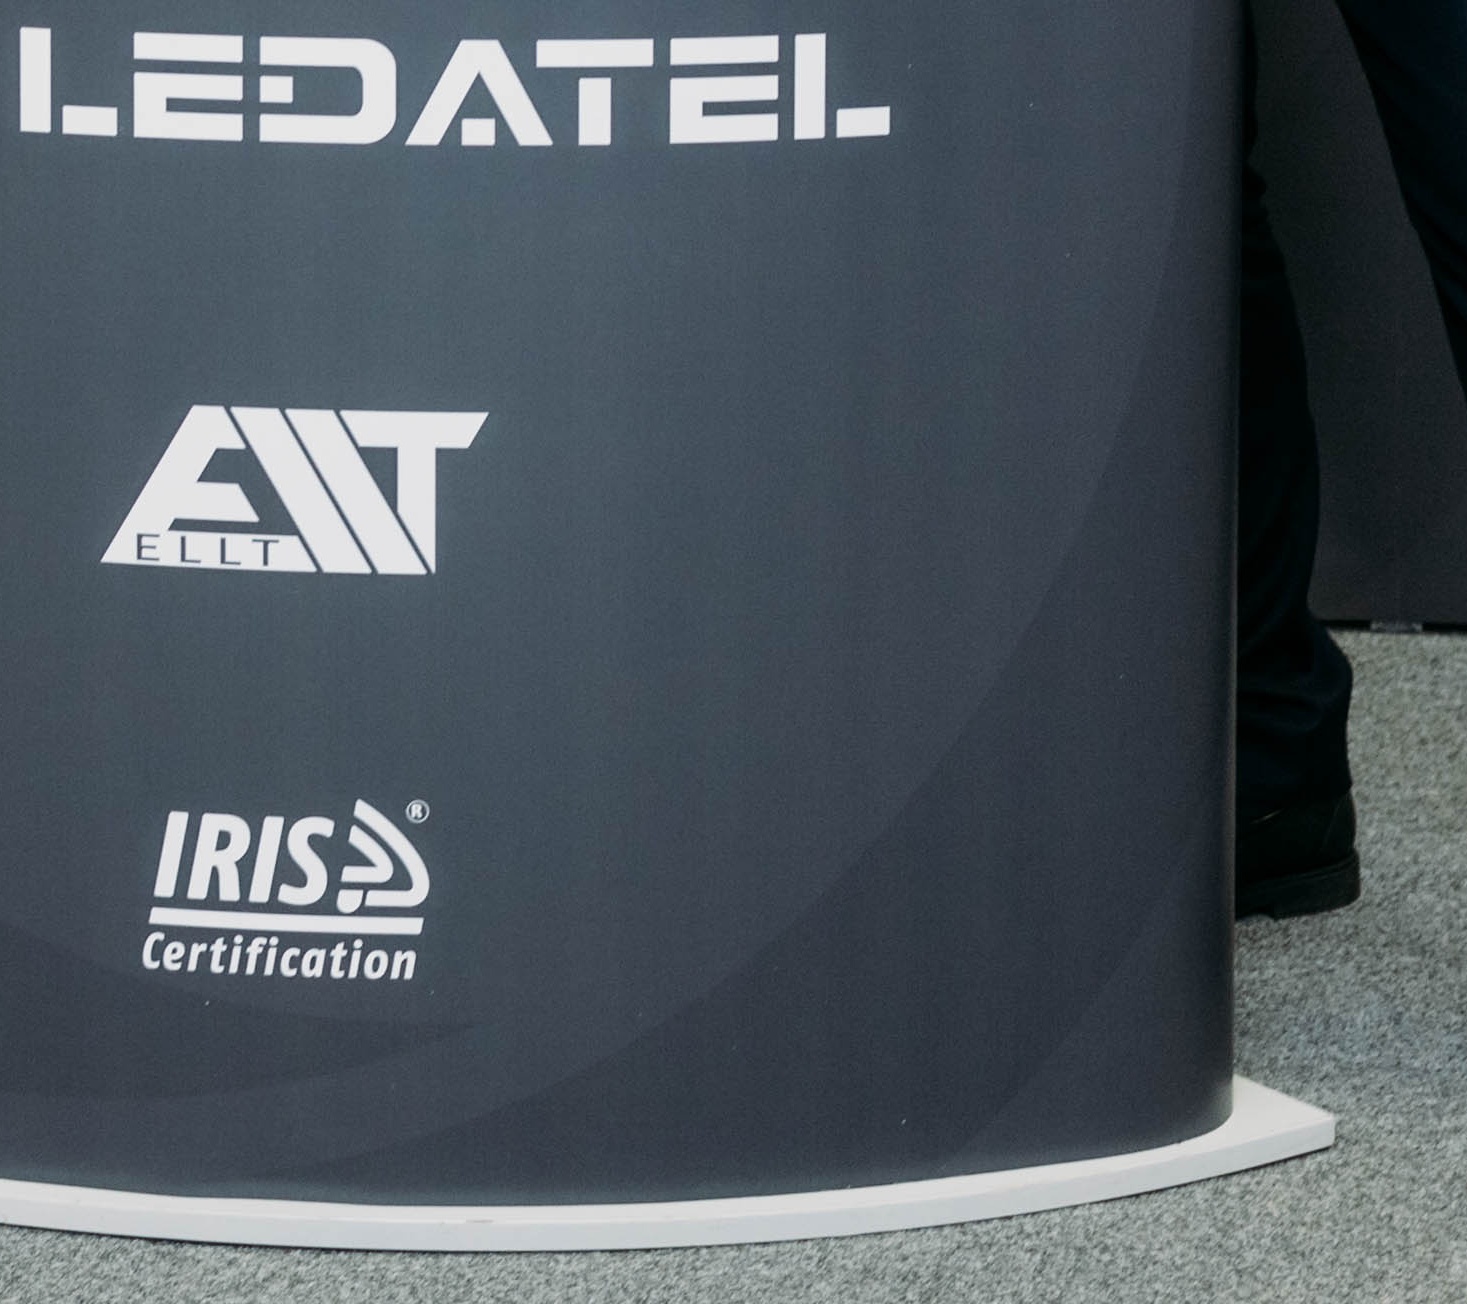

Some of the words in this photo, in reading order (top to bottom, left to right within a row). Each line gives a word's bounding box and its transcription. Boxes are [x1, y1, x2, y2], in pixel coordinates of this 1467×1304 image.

[18, 25, 891, 147] LEDATEL
[135, 532, 281, 568] ELLT
[153, 810, 335, 906] IRIS
[141, 931, 417, 981] Certification
